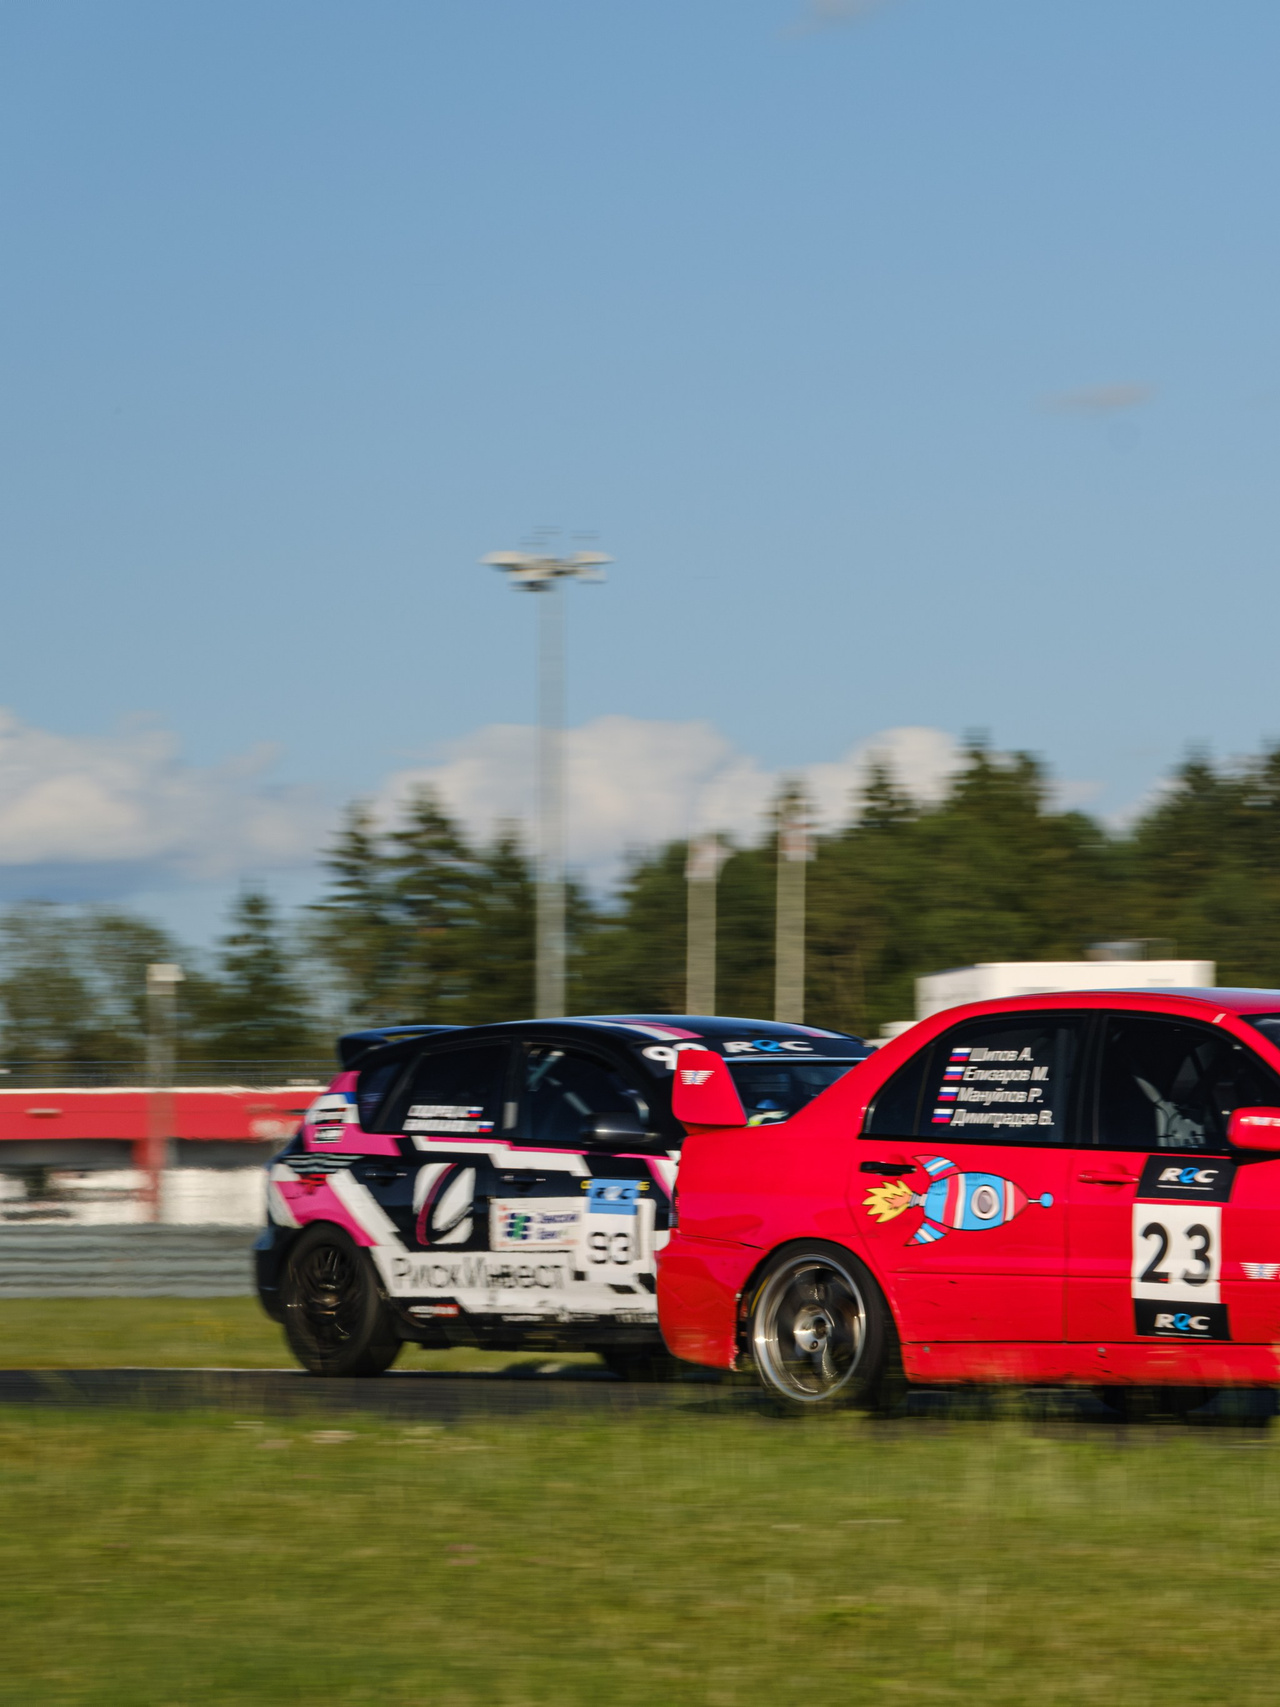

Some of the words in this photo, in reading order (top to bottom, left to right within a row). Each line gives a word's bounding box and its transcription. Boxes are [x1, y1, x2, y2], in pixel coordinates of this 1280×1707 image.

[642, 1042, 708, 1070] 9
[1017, 1047, 1034, 1062] А.
[1030, 1066, 1050, 1081] М.
[1038, 1110, 1055, 1126] В.
[587, 1231, 632, 1265] 93
[1139, 1222, 1213, 1288] 23
